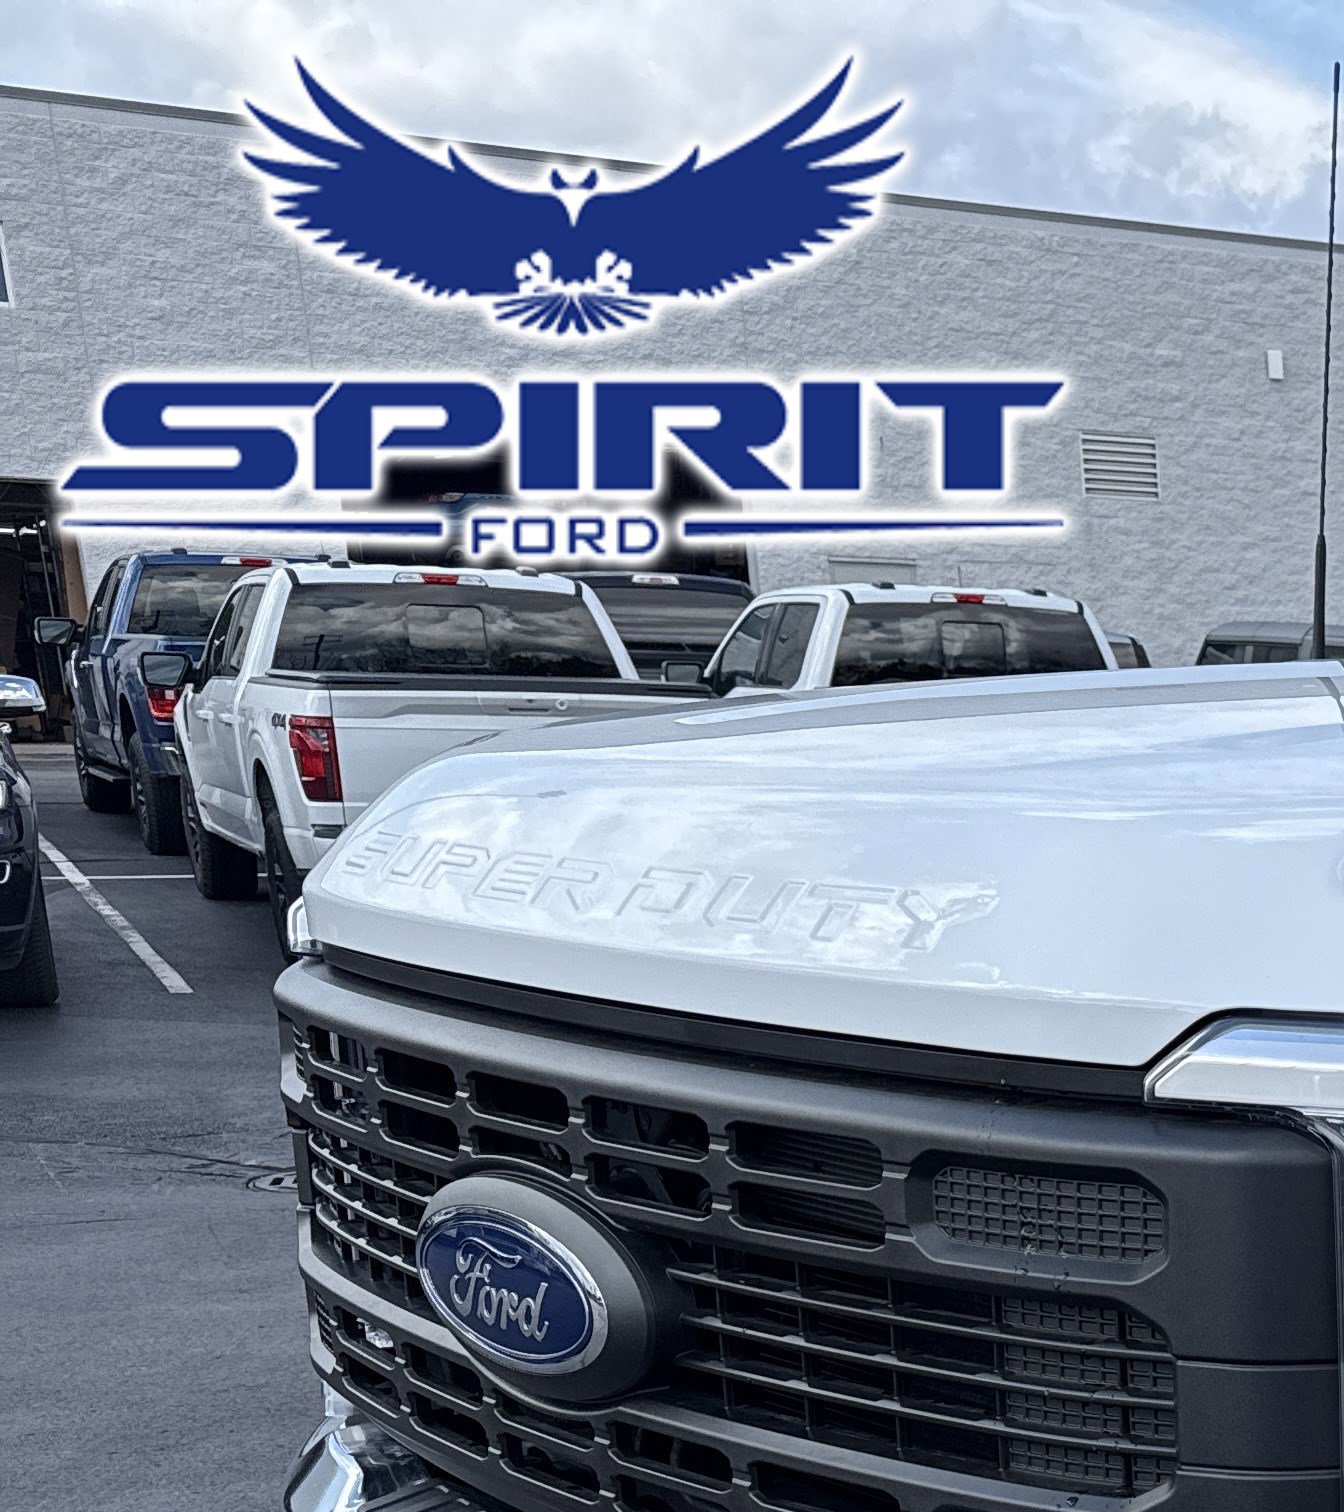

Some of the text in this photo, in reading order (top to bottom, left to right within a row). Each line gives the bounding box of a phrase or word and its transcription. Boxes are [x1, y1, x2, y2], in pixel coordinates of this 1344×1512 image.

[342, 830, 615, 912] SUPER
[615, 866, 1000, 952] DUTY
[450, 1236, 549, 1343] Ford
